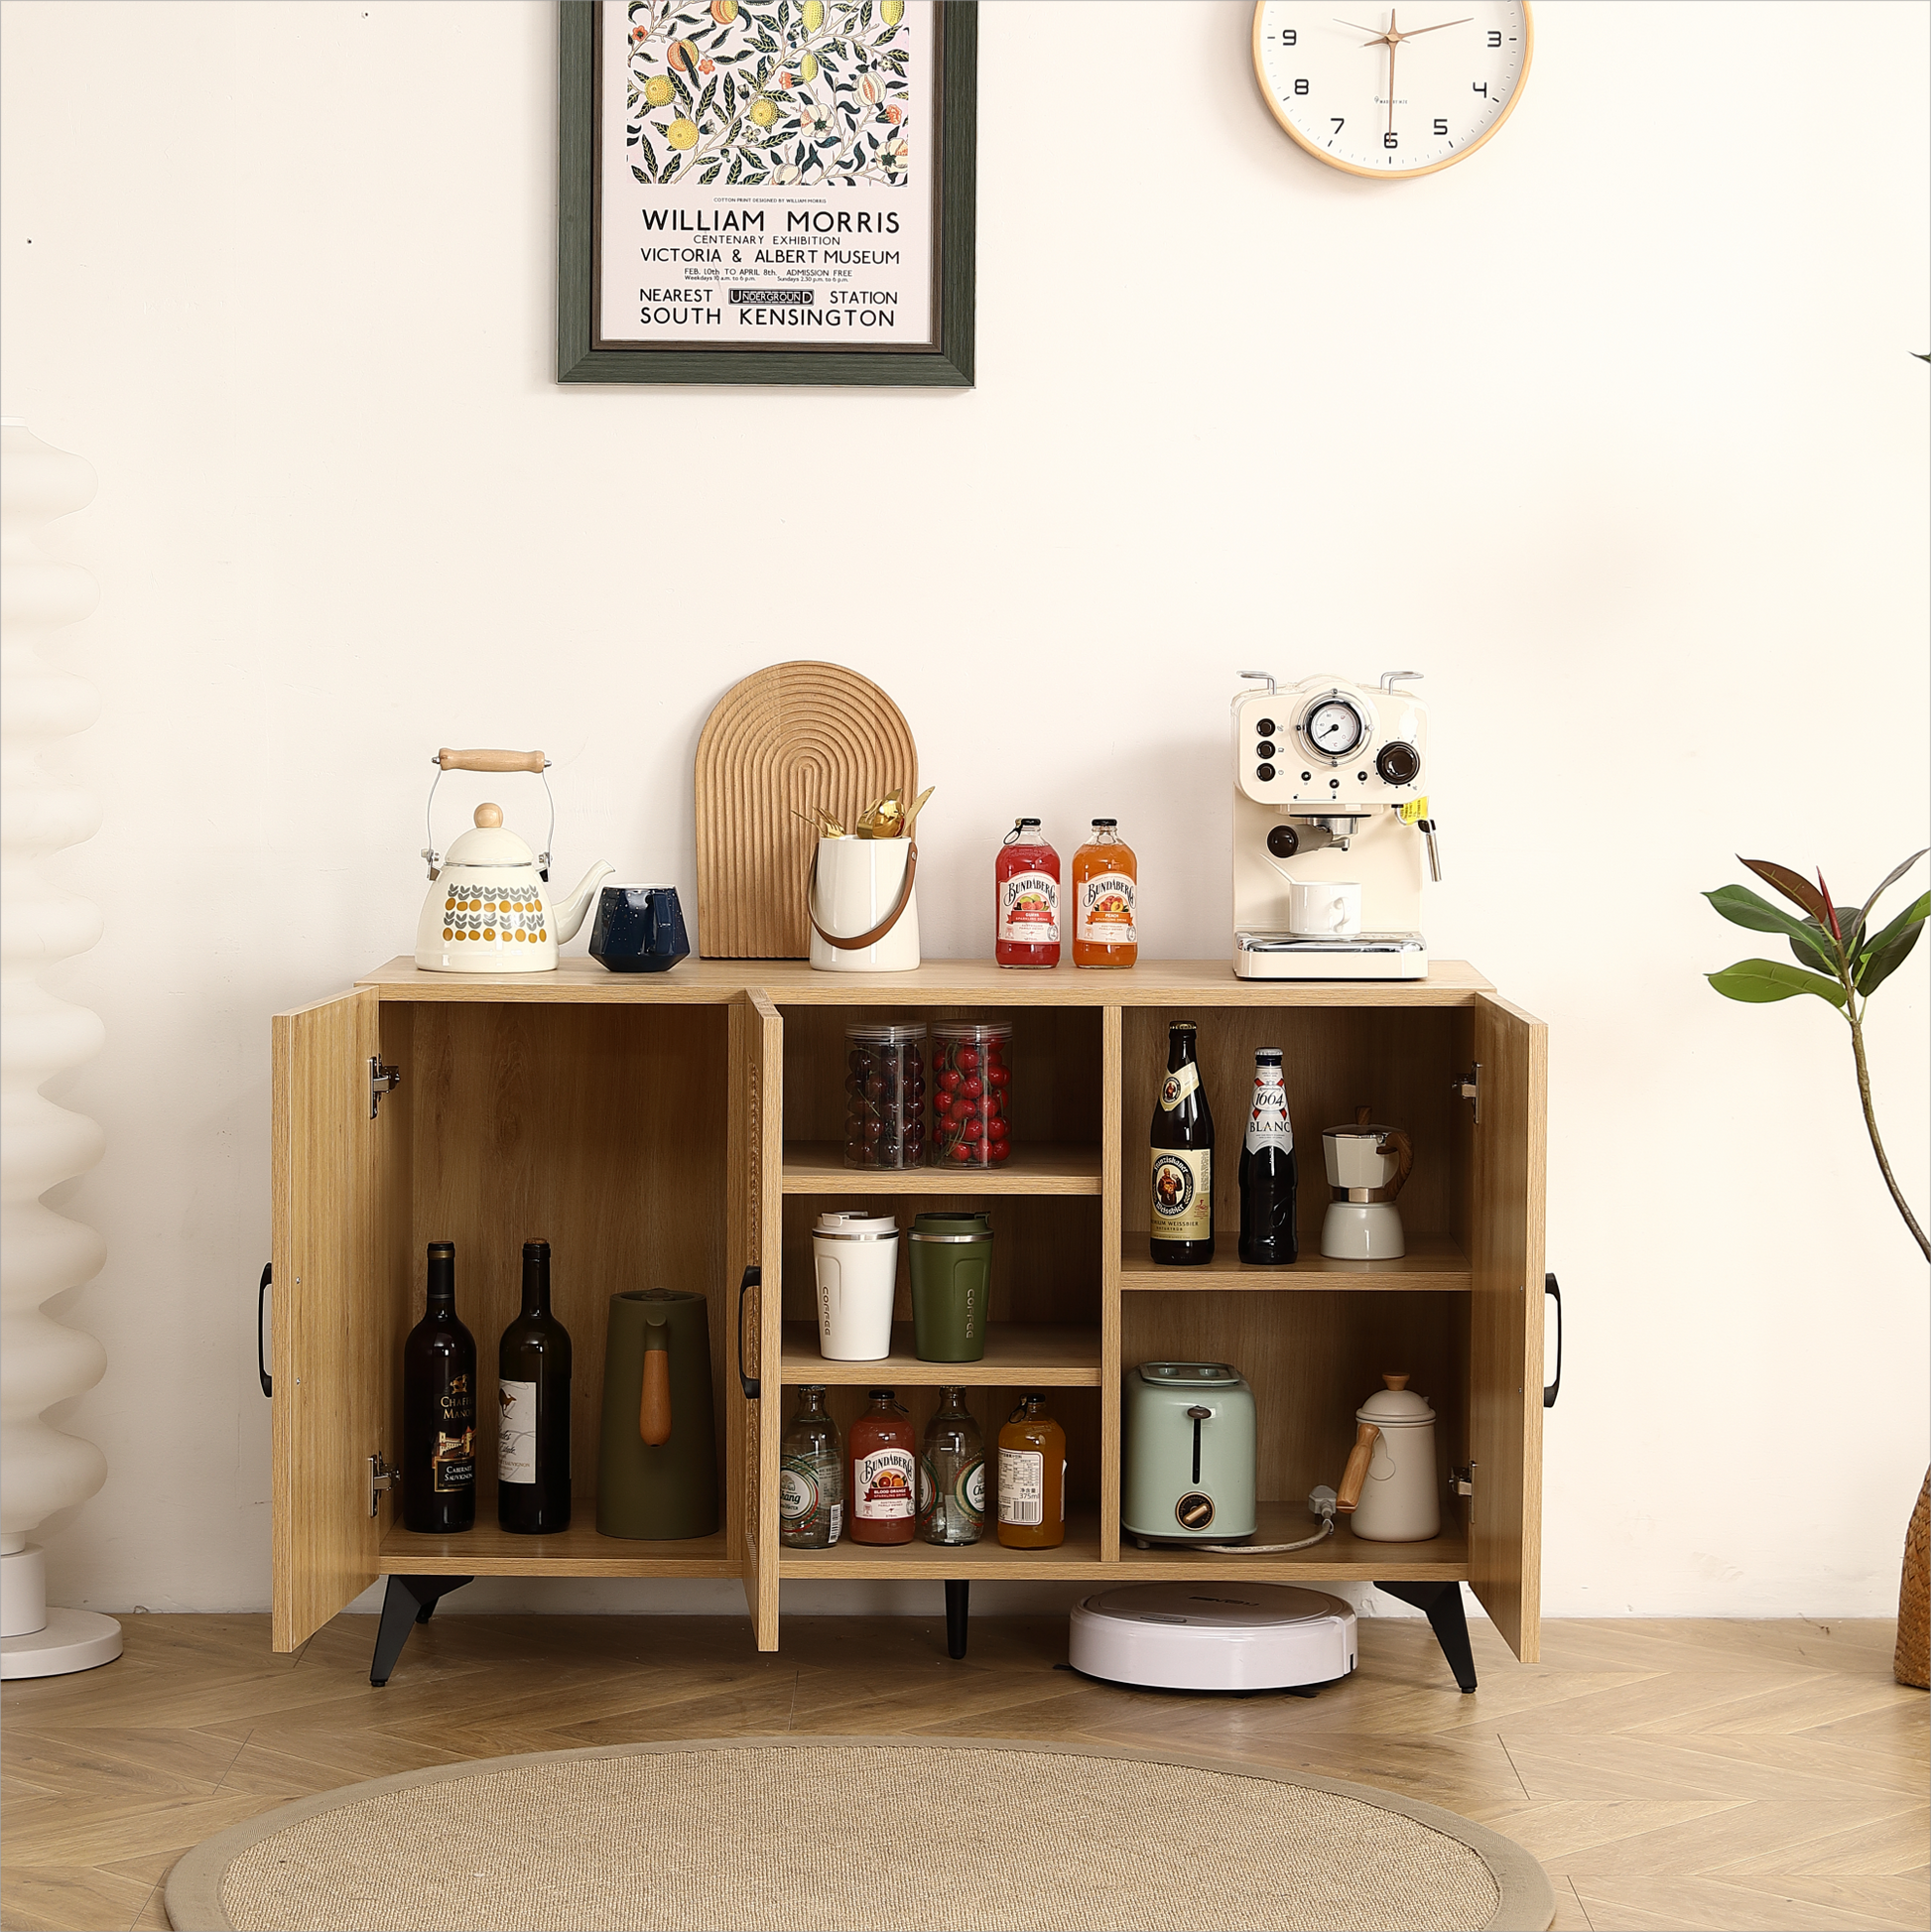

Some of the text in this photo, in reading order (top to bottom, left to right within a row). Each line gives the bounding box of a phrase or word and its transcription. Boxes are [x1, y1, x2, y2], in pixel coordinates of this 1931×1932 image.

[1282, 29, 1297, 46] 9
[1486, 31, 1501, 48] 3
[1294, 78, 1310, 95] 8
[1473, 81, 1487, 98] 4
[1330, 118, 1345, 135] 7
[1433, 118, 1448, 135] 5
[1383, 132, 1398, 149] 6
[642, 209, 900, 234] WILLIAM MORRIS
[694, 235, 840, 246] CENTENARY EXHIBITION
[641, 248, 900, 265] VICTORIA & ALBERT MUSEUM
[640, 289, 898, 305] NEAREST UNDERGROUND STATION
[640, 308, 894, 326] SOUTH KENSINGTON
[1003, 877, 1058, 908] BUNDABERG
[1083, 878, 1136, 909] BUNDABERG
[1255, 1091, 1284, 1106] 1664
[1249, 1121, 1291, 1132] BLANC
[822, 1286, 831, 1336] COFFEE
[966, 1288, 975, 1339] COFFEE
[445, 1473, 472, 1481] SAUVIGNON
[446, 1465, 472, 1474] CABERNET
[859, 1454, 914, 1484] BUNDABERG
